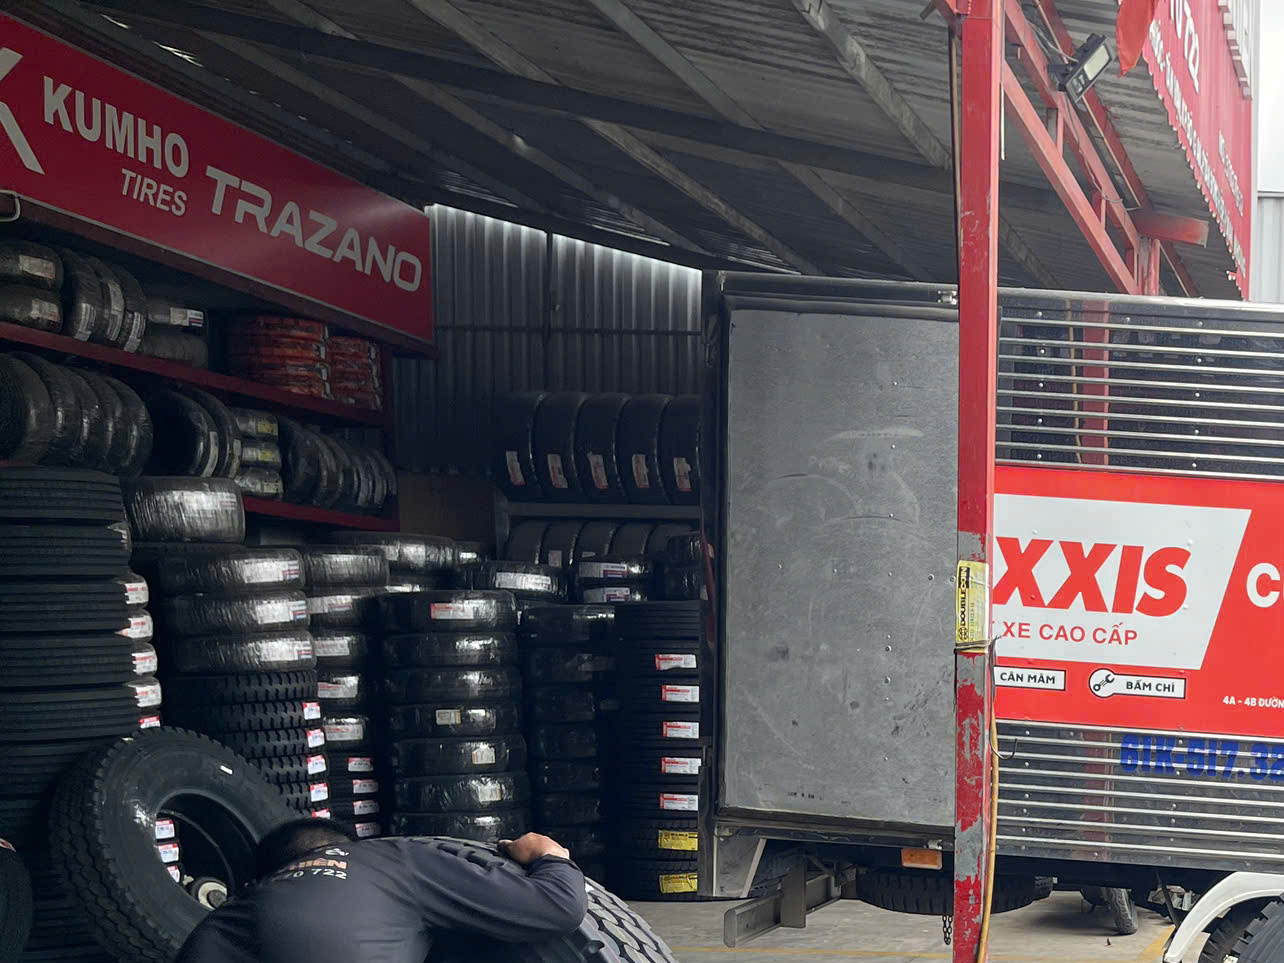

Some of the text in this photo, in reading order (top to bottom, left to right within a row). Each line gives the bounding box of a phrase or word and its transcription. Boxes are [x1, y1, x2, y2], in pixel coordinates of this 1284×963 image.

[44, 76, 190, 178] KUMHO
[121, 168, 187, 217] TIRES
[206, 166, 422, 292] TRAZANO
[1002, 622, 1138, 645] XE CAO CẤP
[1223, 696, 1236, 705] 4A
[1244, 697, 1256, 707] 4B
